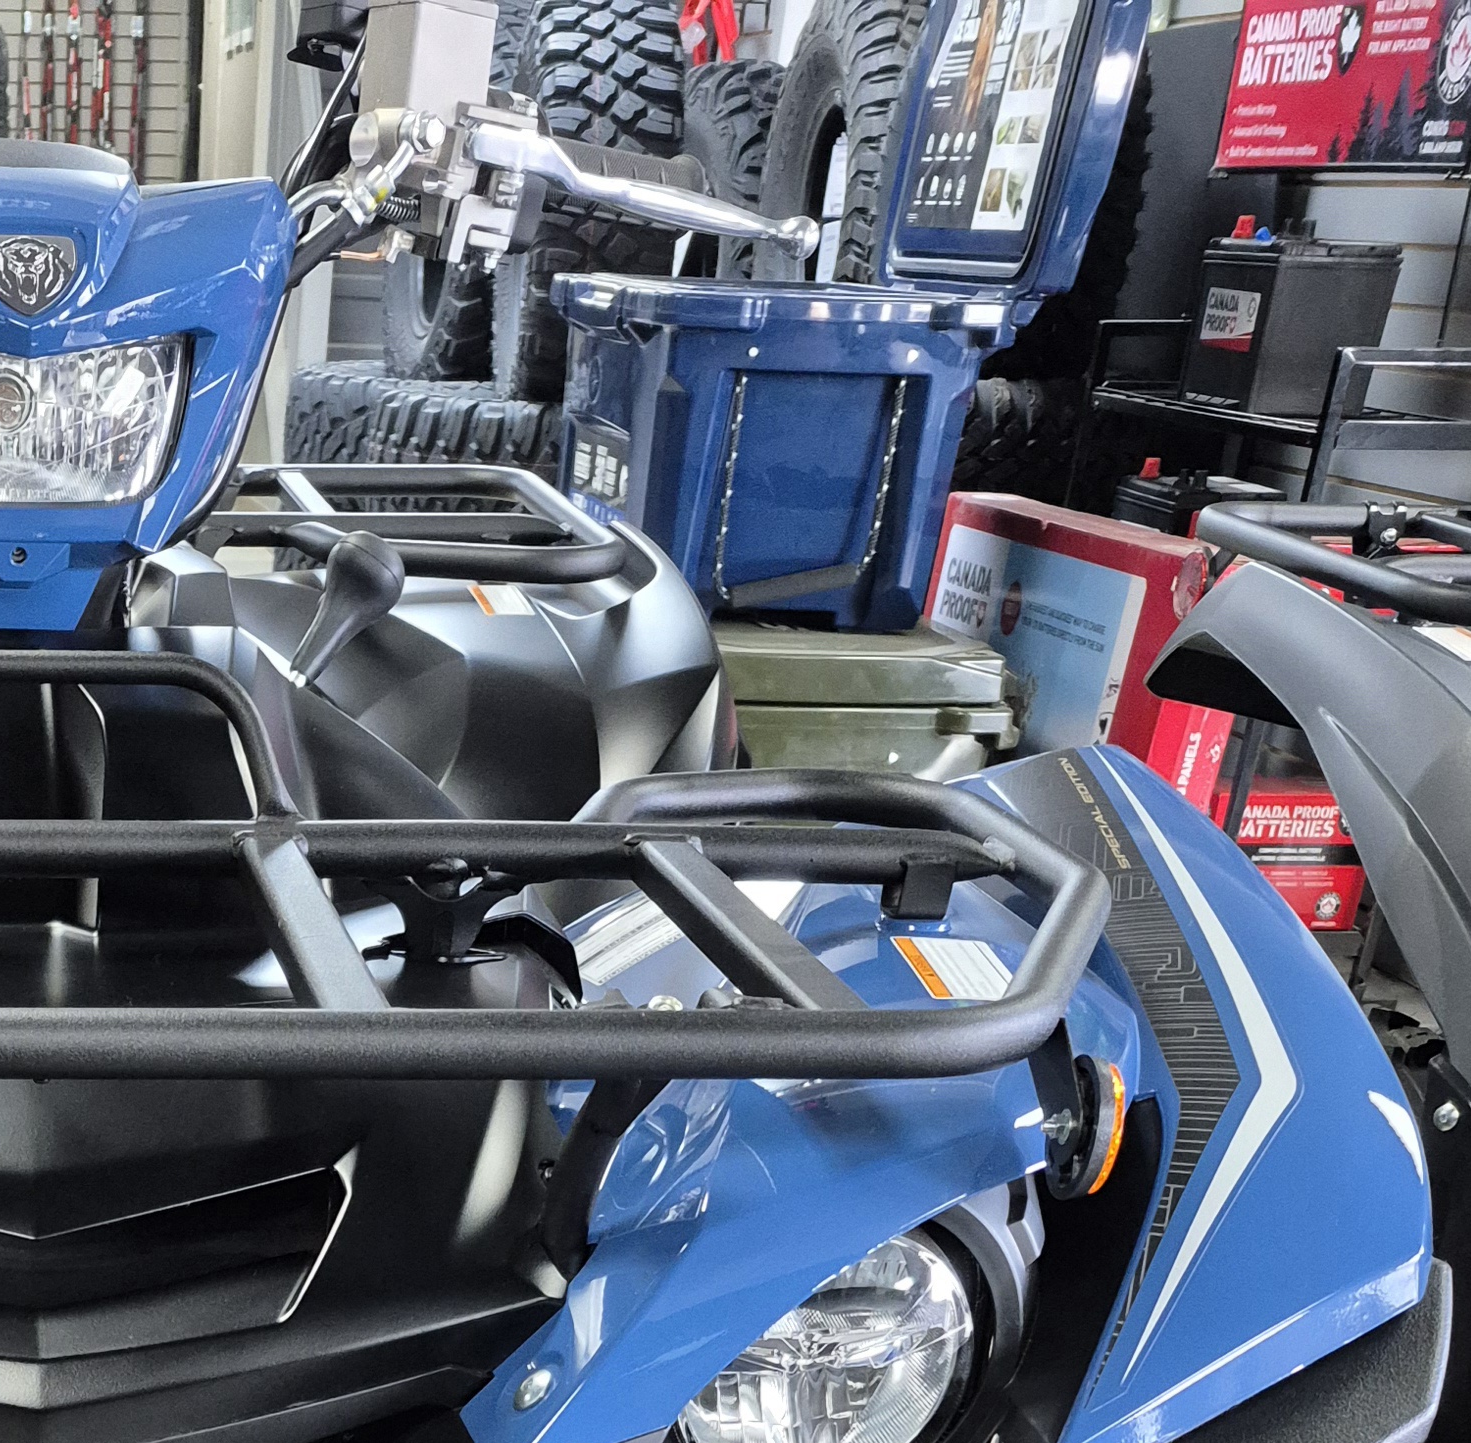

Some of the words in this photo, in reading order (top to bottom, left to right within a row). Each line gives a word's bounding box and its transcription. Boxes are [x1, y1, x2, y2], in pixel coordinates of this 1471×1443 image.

[1246, 12, 1297, 43] CANADA
[1297, 5, 1343, 39] PROOF
[1238, 39, 1336, 87] BATTERIES
[1209, 292, 1239, 313] CANADA
[947, 557, 992, 597] CANADA
[939, 589, 979, 626] PROOF
[1177, 732, 1202, 785] PANELS
[1057, 757, 1095, 804] EDITION
[1242, 805, 1290, 819] ANADA
[1292, 805, 1340, 819] PROOF
[1091, 804, 1132, 870] SPECIAL
